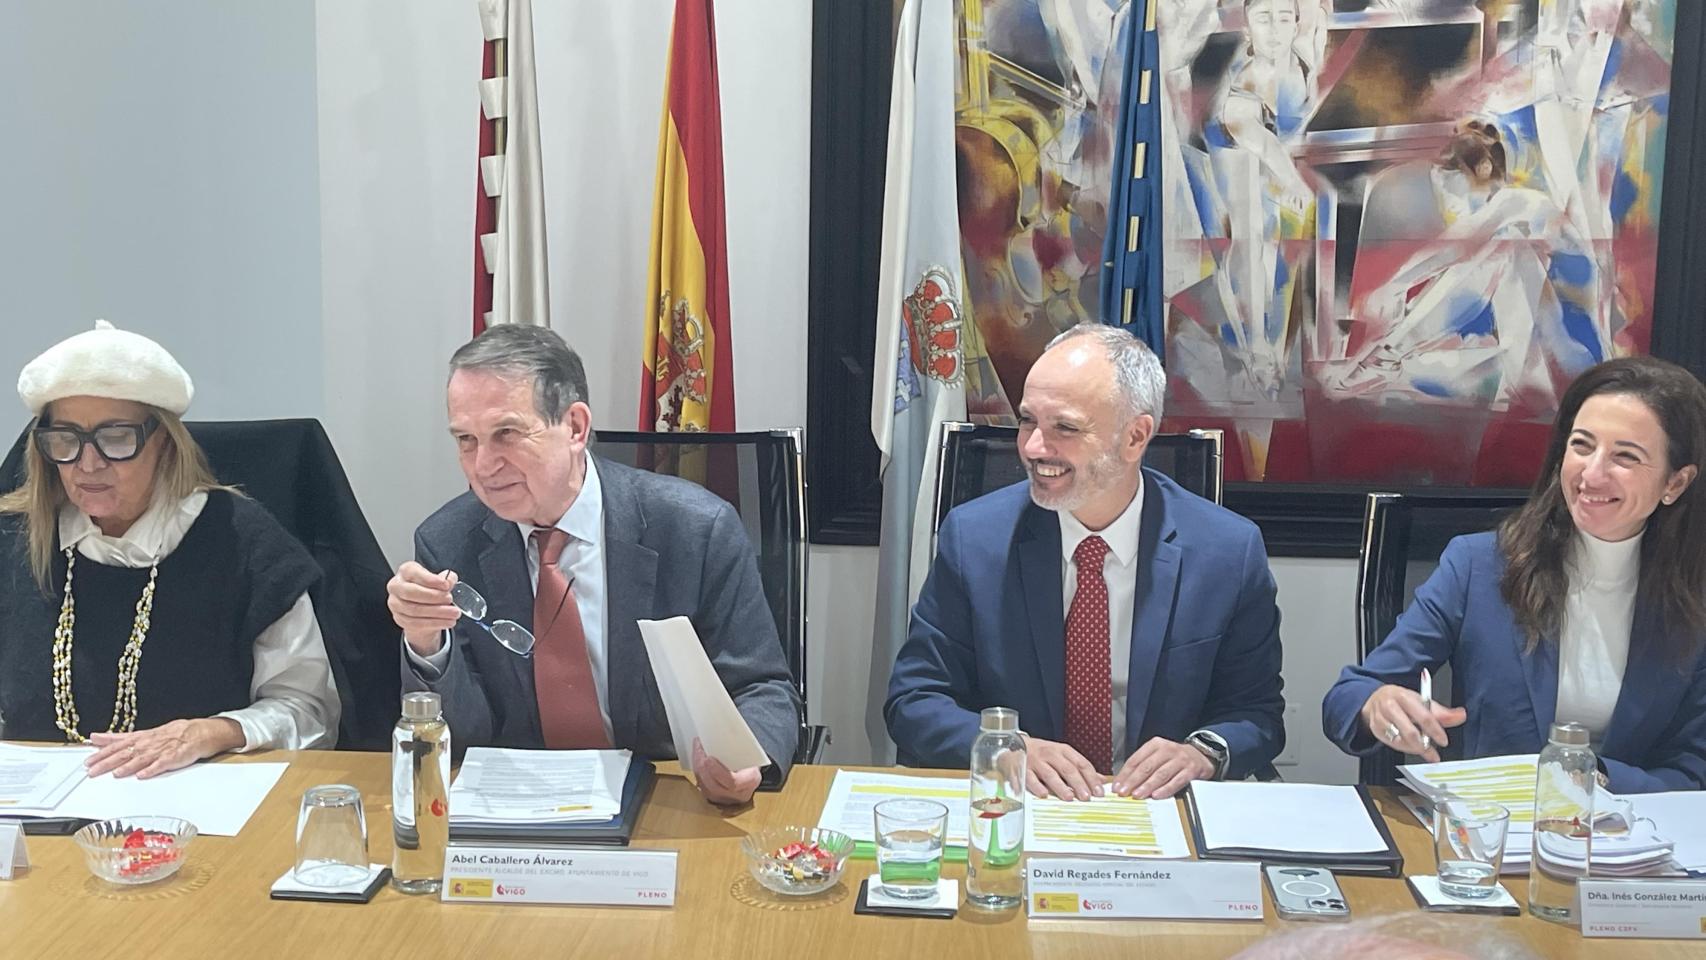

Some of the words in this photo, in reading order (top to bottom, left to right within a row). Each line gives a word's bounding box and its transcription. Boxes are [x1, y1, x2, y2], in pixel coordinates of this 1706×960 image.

[452, 855, 477, 864] Abel
[480, 855, 531, 865] Caballero
[533, 853, 574, 866] Álvarez
[1033, 869, 1064, 879] David
[1067, 869, 1112, 881] Regades
[1114, 870, 1171, 880] Fernández
[505, 888, 526, 896] VIGO
[638, 891, 668, 899] PLENO
[1588, 891, 1609, 900] Dña.
[1612, 892, 1632, 901] Inés
[1634, 892, 1677, 902] González
